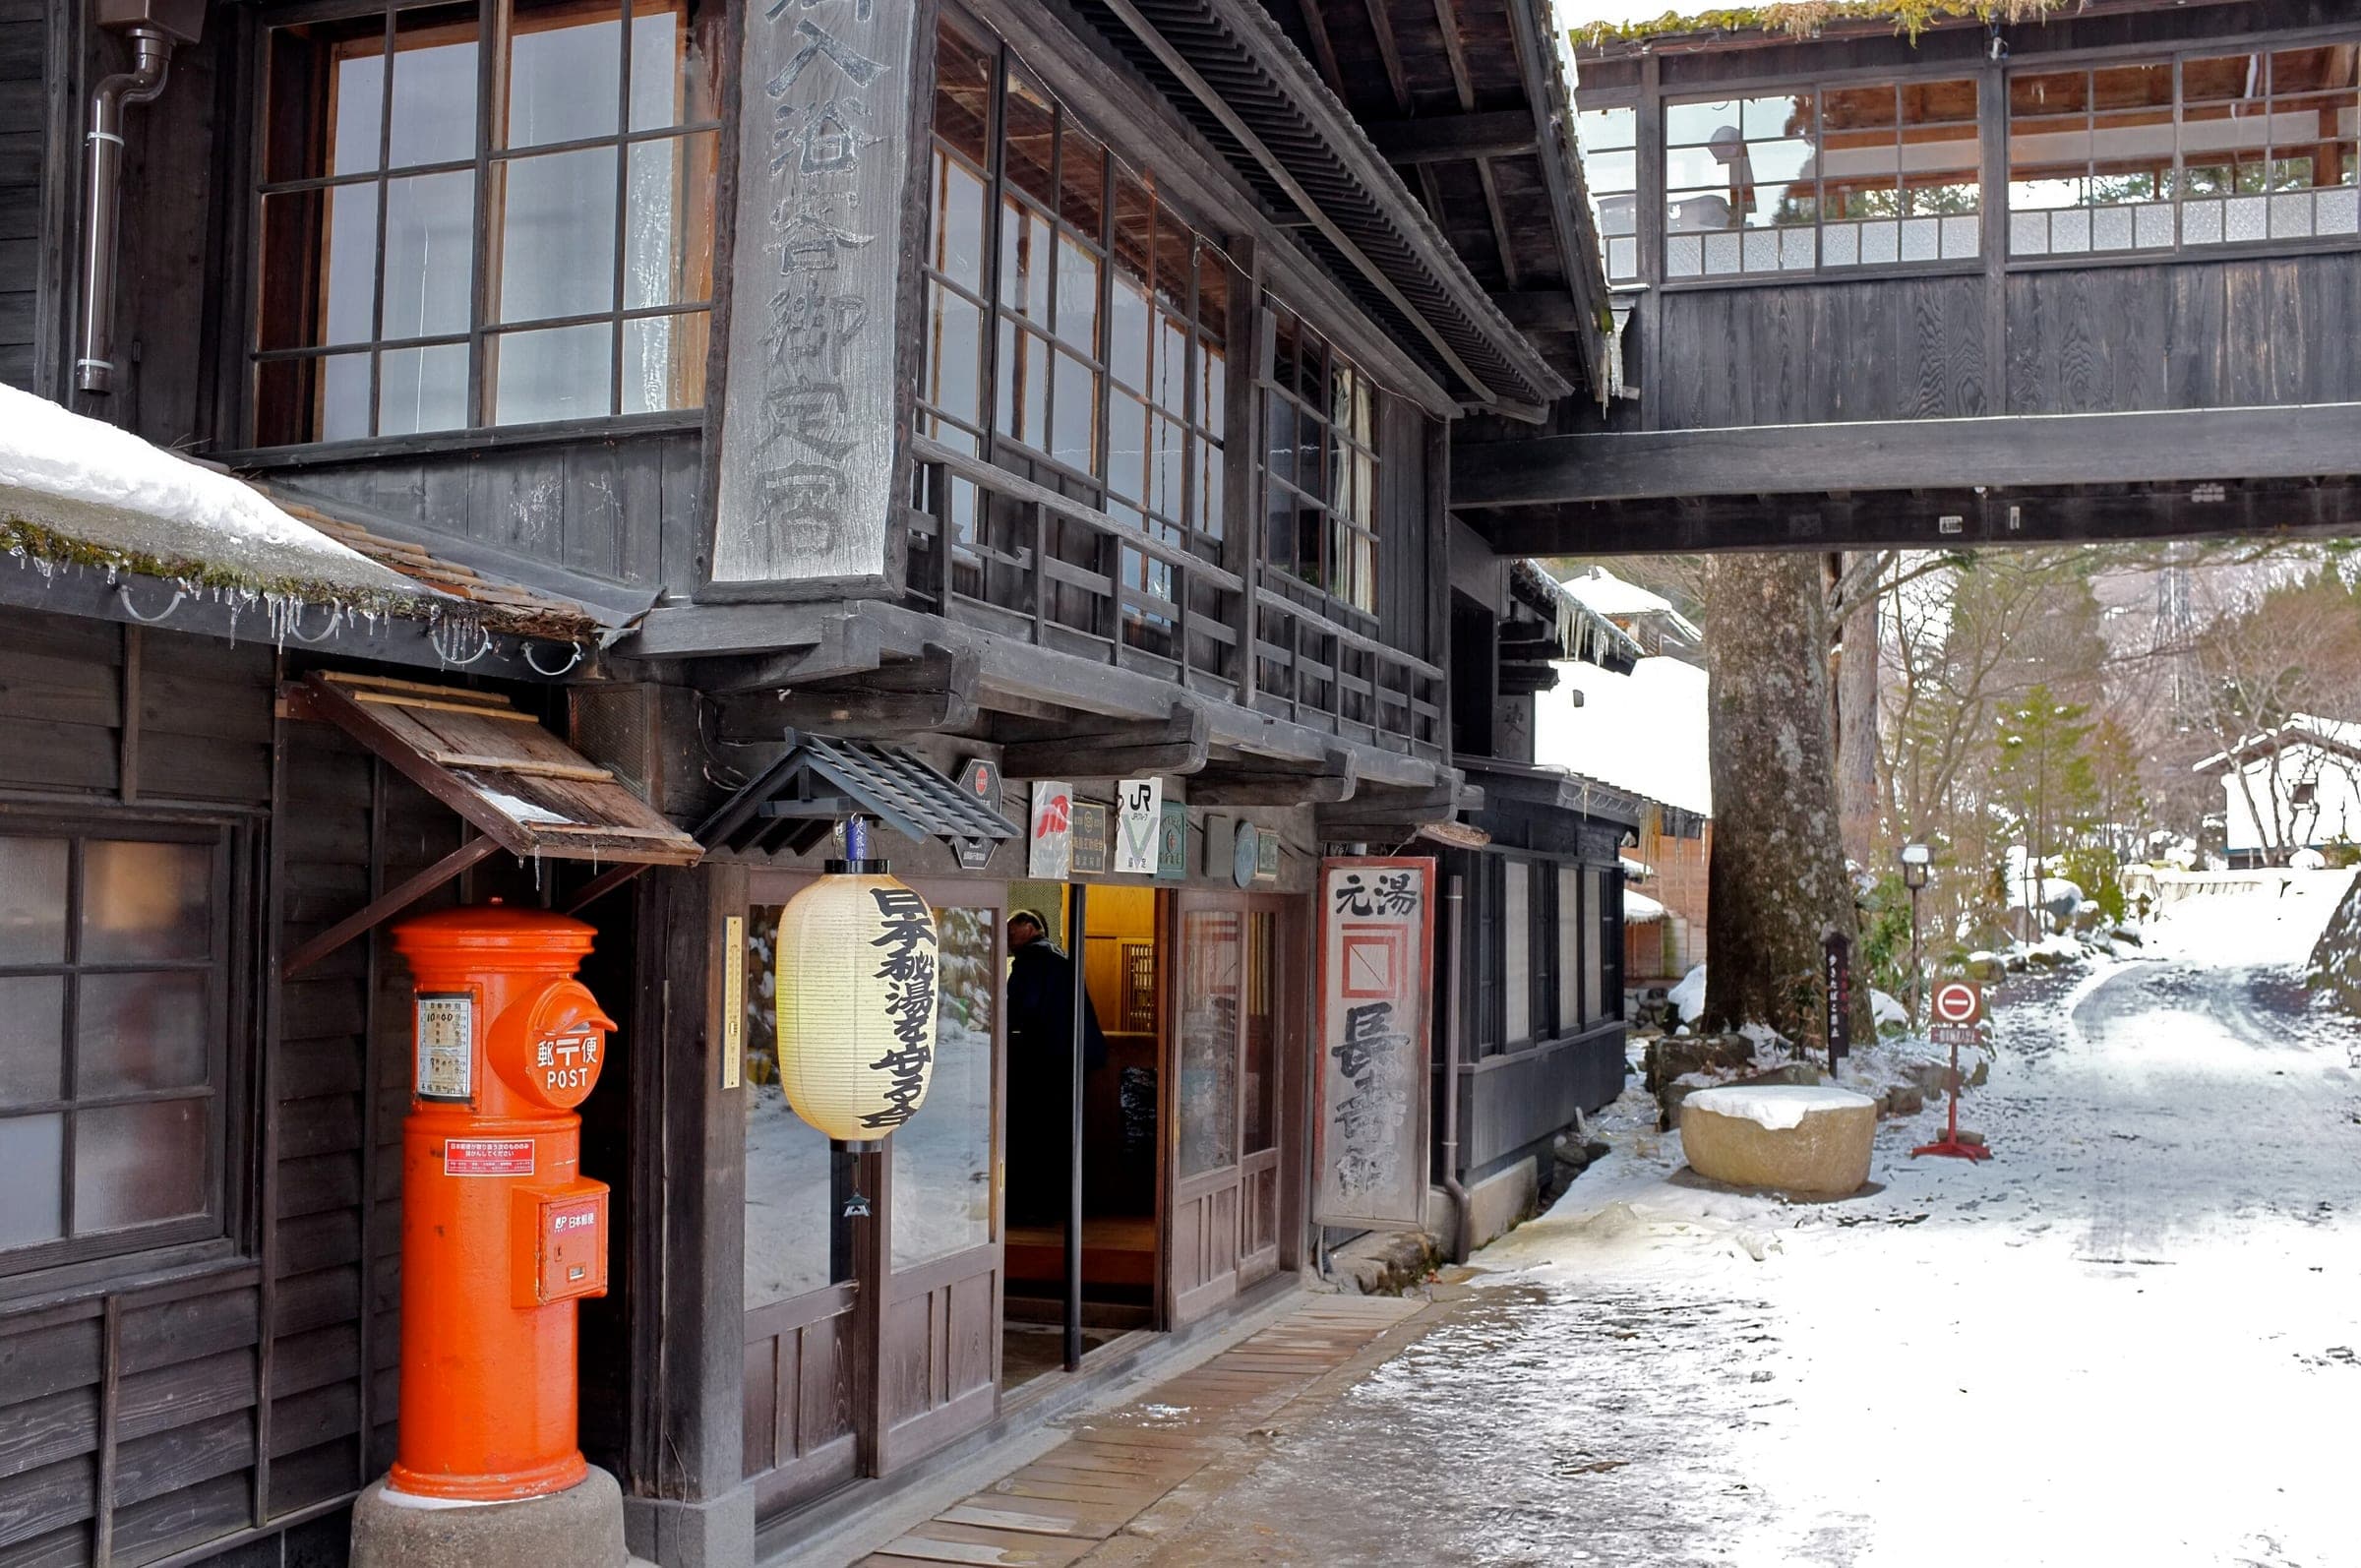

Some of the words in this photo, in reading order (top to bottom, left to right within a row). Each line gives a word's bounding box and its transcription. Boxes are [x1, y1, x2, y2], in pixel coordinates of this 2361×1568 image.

[1130, 784, 1151, 812] JR
[1336, 873, 1418, 917] 元湯
[857, 887, 938, 1129] 日本秘湯を守る会
[546, 1068, 588, 1089] POST
[569, 1212, 595, 1229] 日本郵便
